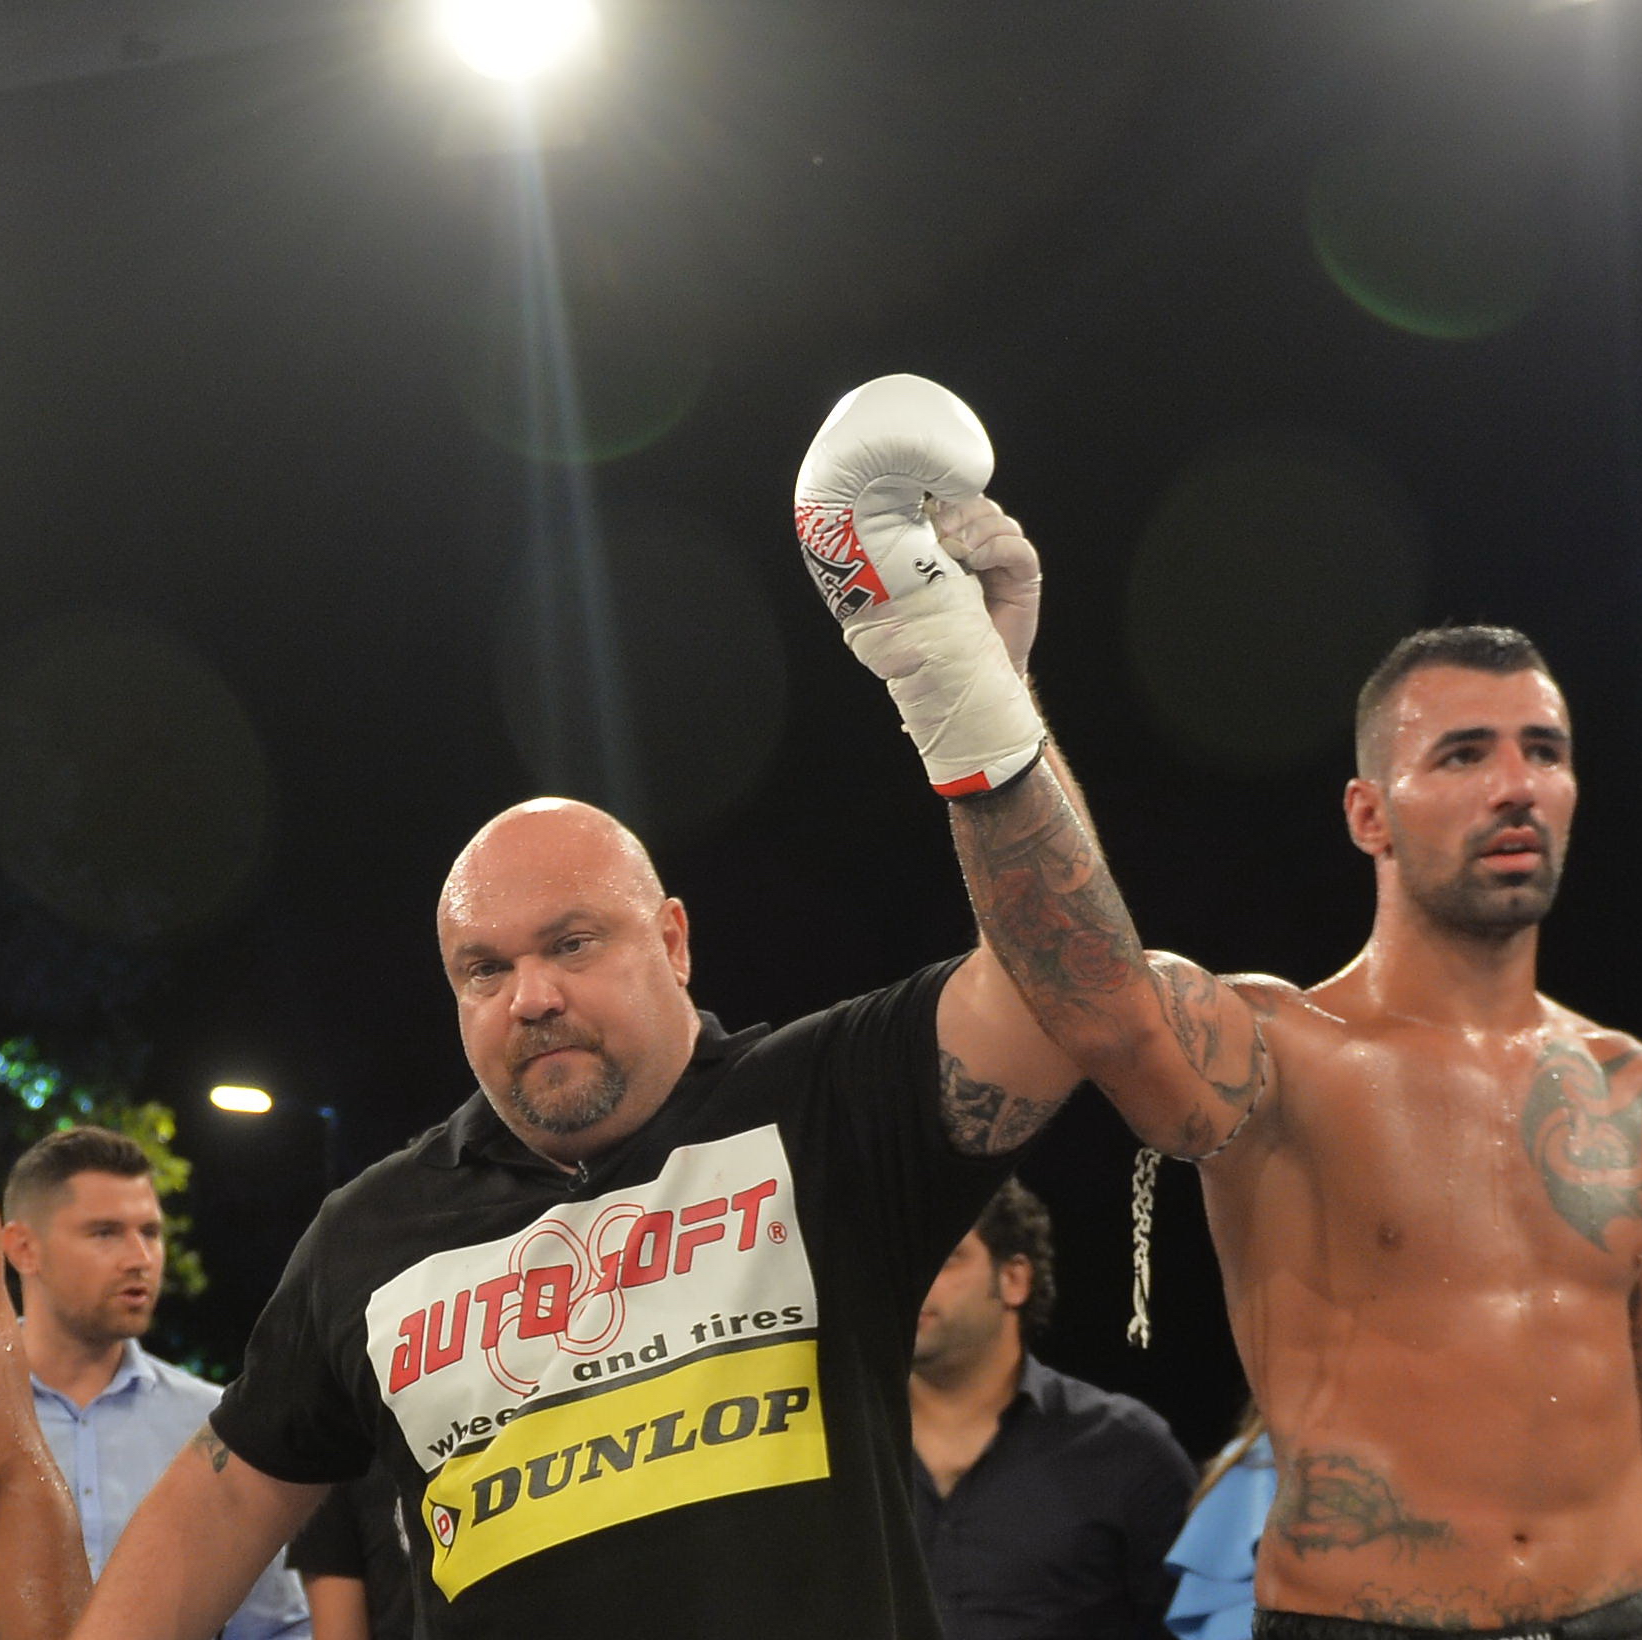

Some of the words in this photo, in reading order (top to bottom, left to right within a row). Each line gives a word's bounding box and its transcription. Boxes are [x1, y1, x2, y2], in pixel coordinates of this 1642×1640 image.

[571, 1333, 669, 1383] and
[690, 1304, 805, 1346] tires
[470, 1386, 810, 1529] DUNLOP
